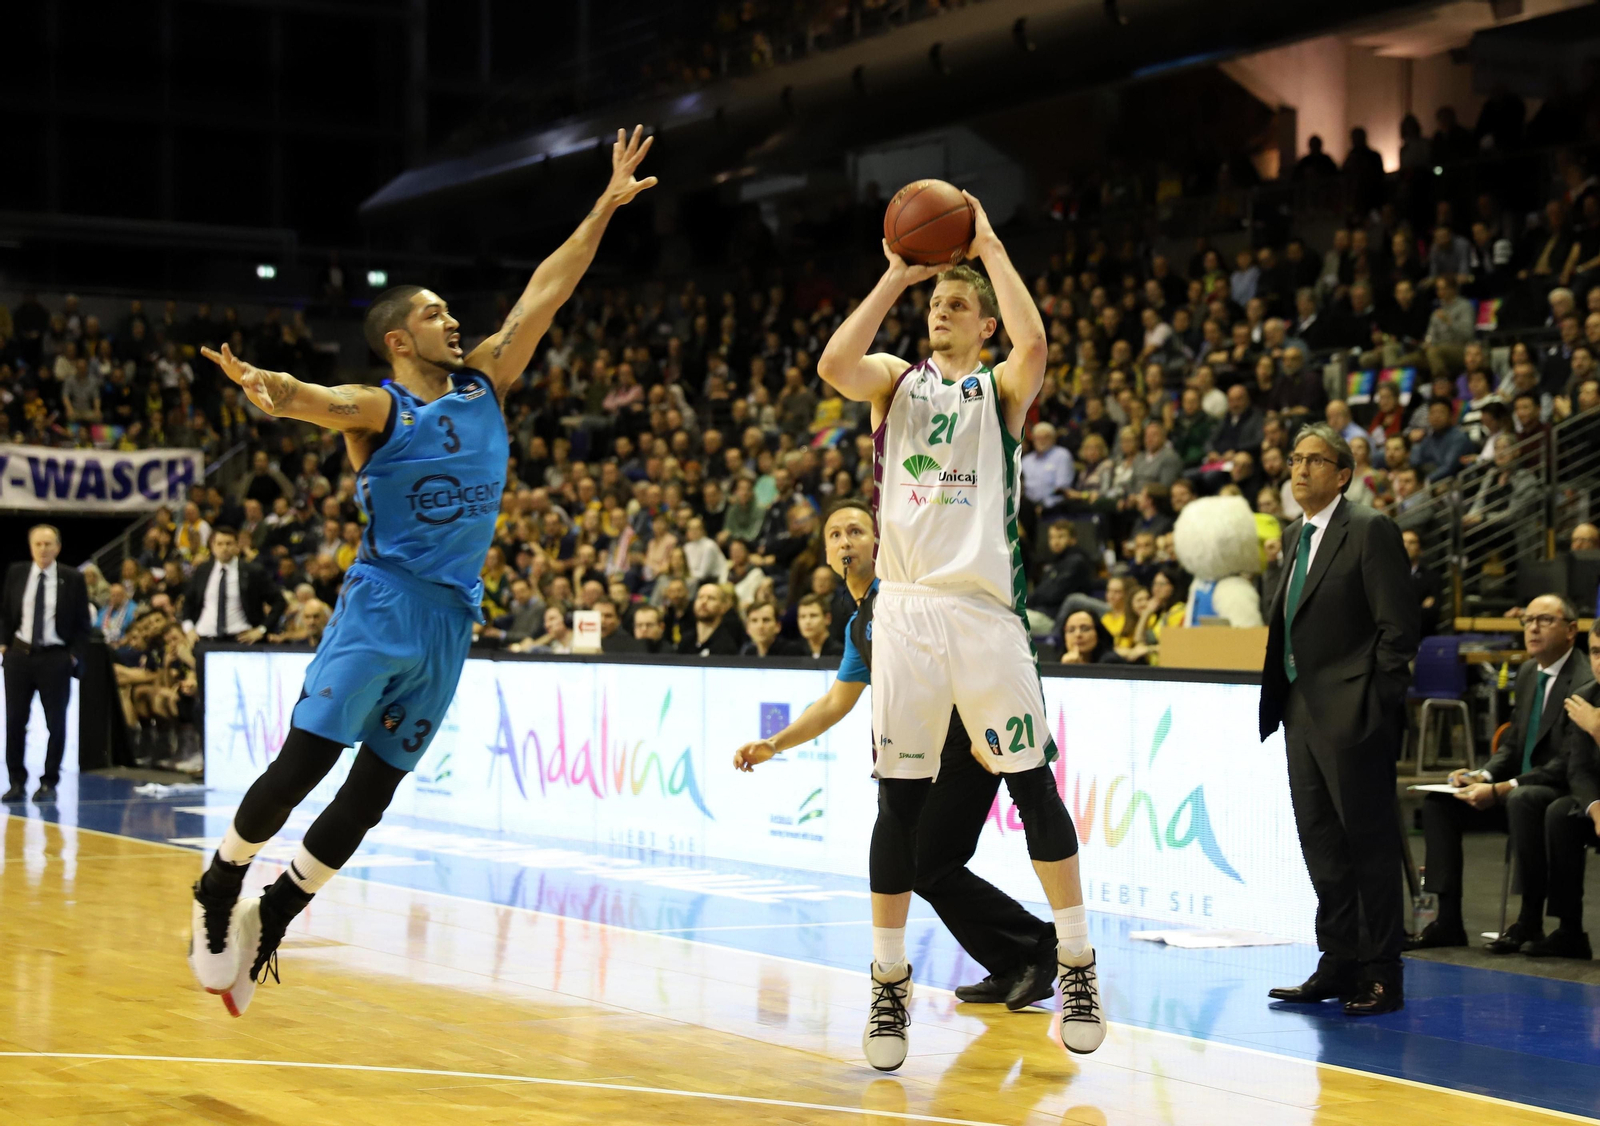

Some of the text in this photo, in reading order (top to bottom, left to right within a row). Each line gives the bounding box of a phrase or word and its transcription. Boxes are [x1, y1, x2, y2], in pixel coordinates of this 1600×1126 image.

[438, 415, 461, 453] 3
[928, 412, 958, 446] 21
[938, 469, 977, 485] Unicaj
[402, 718, 433, 753] 3
[485, 677, 716, 821] Andalucía
[1005, 713, 1035, 754] 21
[1088, 879, 1213, 917] IEBT SIE
